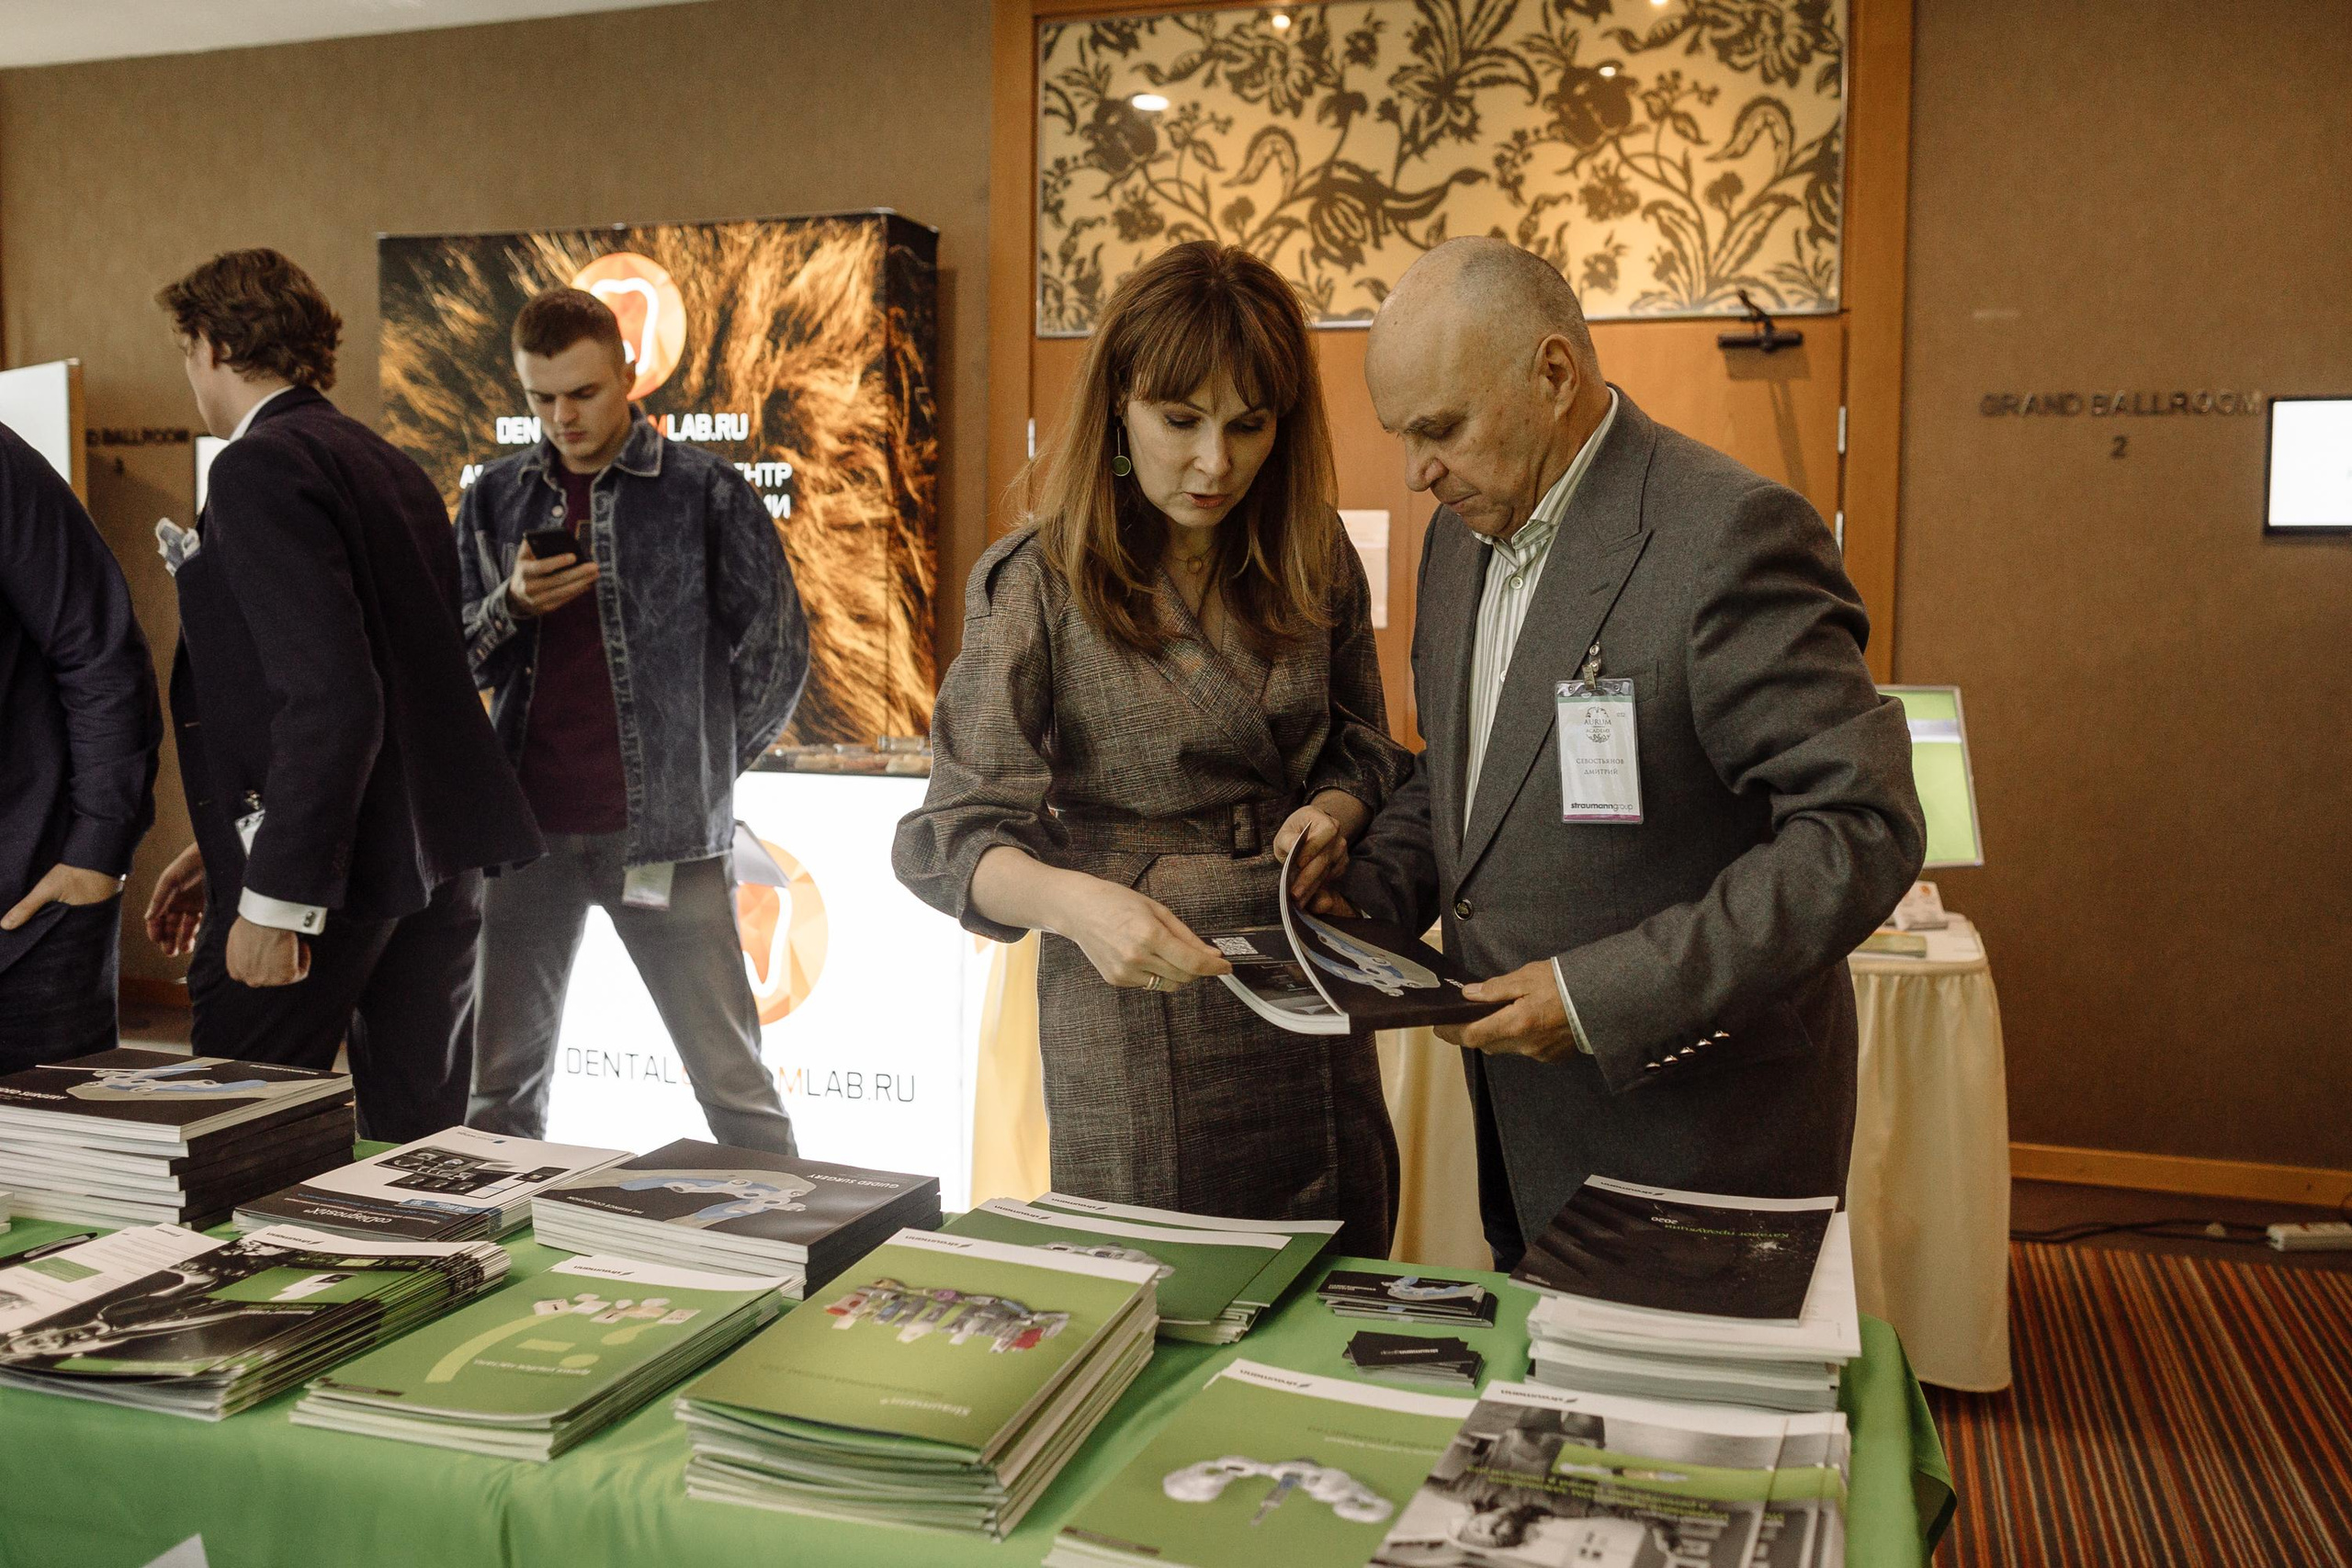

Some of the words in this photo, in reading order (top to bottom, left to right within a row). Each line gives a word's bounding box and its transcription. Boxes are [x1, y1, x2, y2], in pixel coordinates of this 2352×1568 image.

[1980, 392, 2084, 416] GRAND
[2091, 389, 2263, 416] BALLROOM
[2110, 435, 2129, 458] 2
[1650, 1216, 1679, 1224] 2020
